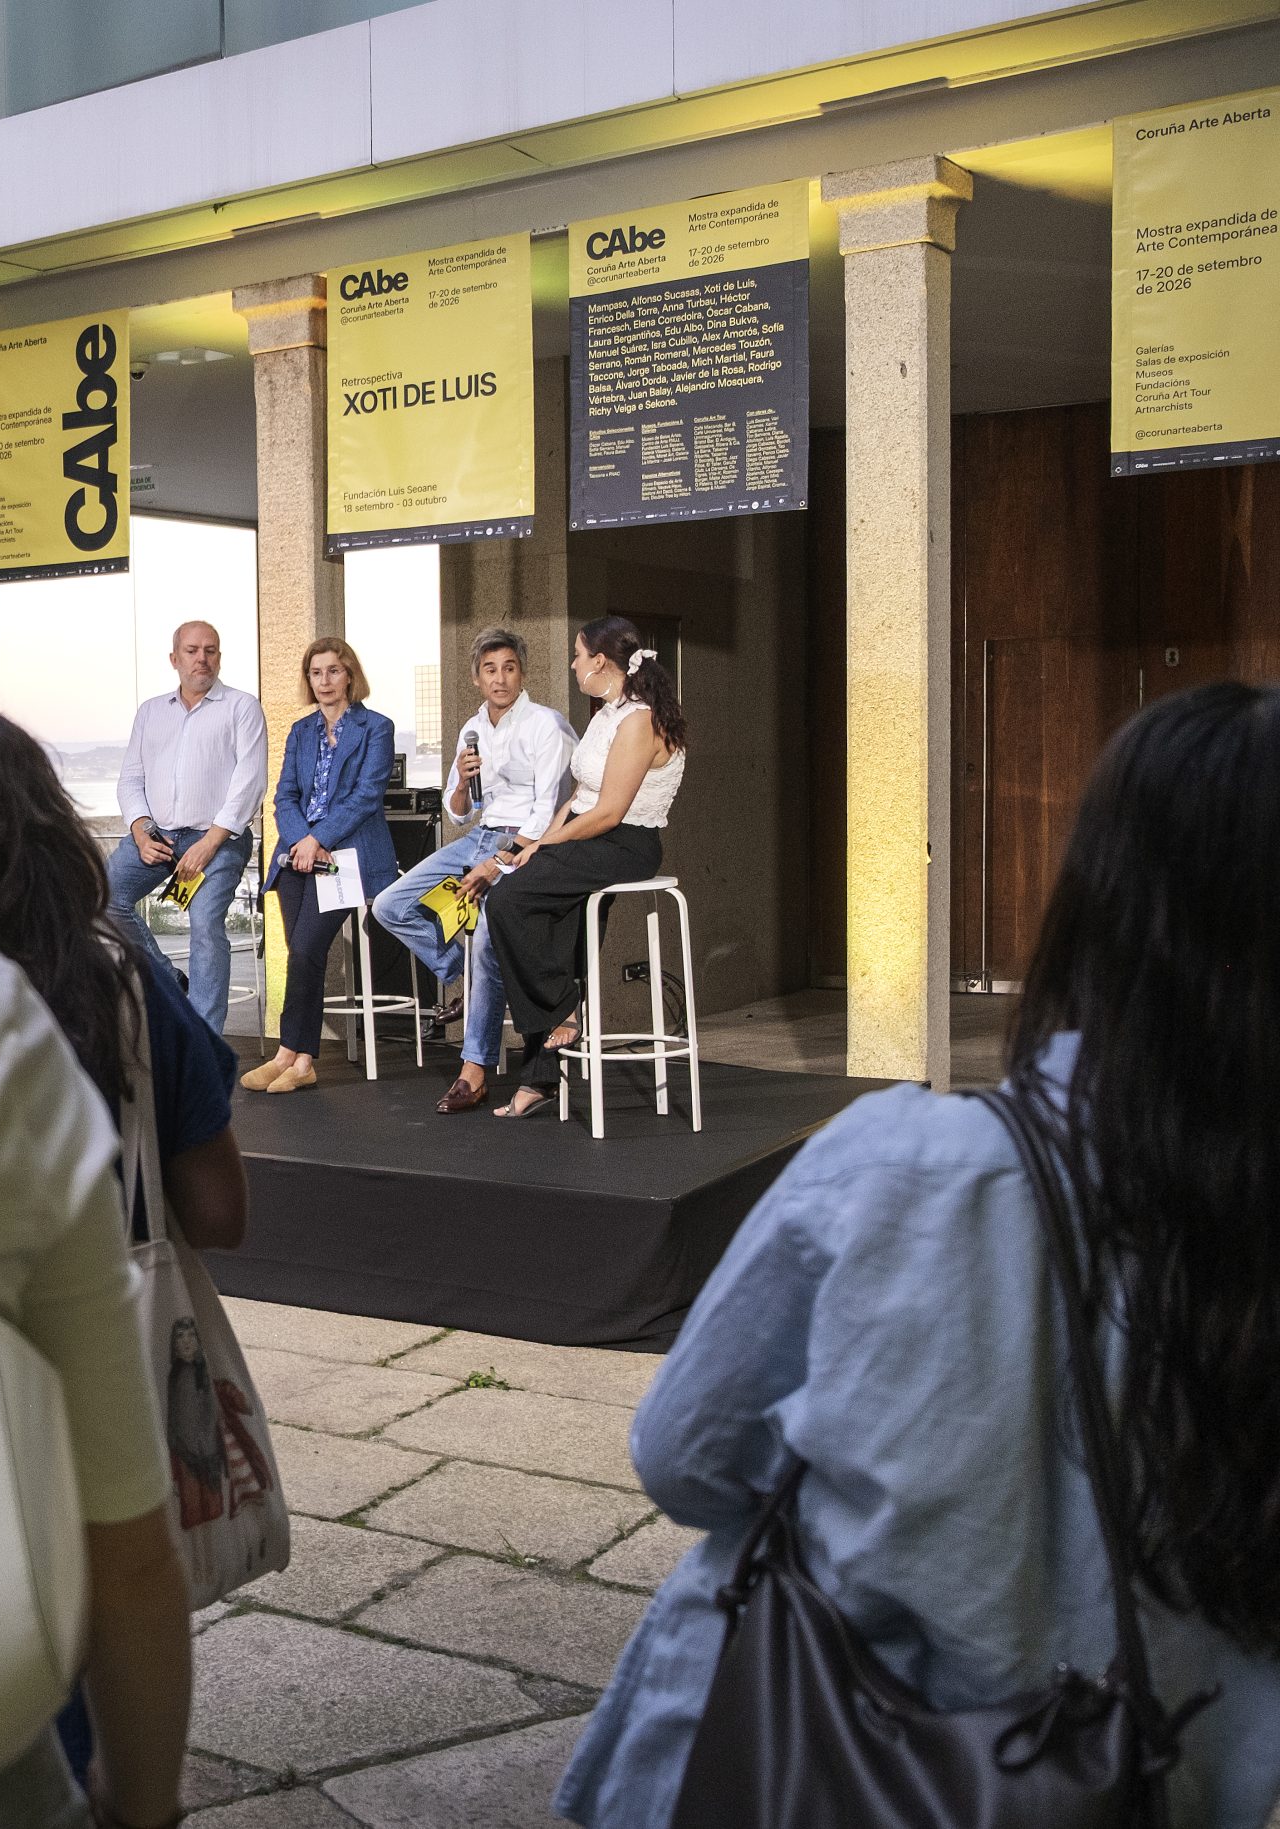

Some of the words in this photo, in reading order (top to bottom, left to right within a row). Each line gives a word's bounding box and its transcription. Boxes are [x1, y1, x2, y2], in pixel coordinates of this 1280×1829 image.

[1136, 123, 1185, 141] Coruña
[1189, 118, 1219, 131] Arte
[1222, 108, 1271, 125] Aberta
[688, 211, 718, 223] Mostra
[720, 202, 766, 217] expandida
[767, 199, 779, 209] de
[688, 223, 707, 233] Arte
[708, 211, 779, 229] Contemporánea
[1137, 225, 1182, 239] Mostra
[1186, 211, 1257, 232] expandida
[1260, 208, 1278, 220] de
[586, 225, 666, 260] CAbe
[689, 245, 713, 257] 17-20
[714, 244, 726, 253] de
[727, 238, 770, 251] setembro
[1136, 241, 1164, 253] Arte
[1168, 224, 1278, 249] Contemporánea
[428, 257, 454, 267] Mostra
[455, 248, 495, 262] expandida
[496, 246, 507, 255] de
[586, 263, 616, 275] Coruña
[618, 260, 636, 270] Arte
[637, 255, 666, 266] Aberta
[688, 259, 700, 268] de
[701, 253, 724, 265] 2026
[428, 268, 444, 276] Arte
[445, 257, 507, 273] Contemporánea
[1136, 266, 1174, 281] 17-20
[1177, 264, 1194, 276] de
[1197, 255, 1262, 273] setembro
[340, 268, 409, 301] CAbe
[587, 266, 660, 287] @corunarteaberta
[1136, 284, 1153, 295] de
[1157, 277, 1192, 293] 2026
[428, 288, 450, 299] 17-20
[451, 287, 461, 296] de
[462, 282, 498, 294] setembro
[588, 300, 629, 314] Mampaso,
[631, 294, 662, 306] Alfonso
[664, 288, 702, 301] Sucasas,
[704, 283, 721, 294] Xoti
[723, 281, 735, 291] de
[340, 304, 366, 315] Coruña
[367, 302, 383, 310] Arte
[384, 297, 409, 307] Aberta
[428, 301, 438, 309] de
[440, 296, 460, 307] 2026
[588, 314, 614, 325] Enrico
[636, 307, 660, 317] Torre,
[662, 303, 684, 313] Anna
[686, 298, 718, 309] Turbau,
[720, 292, 751, 304] Héctor
[340, 307, 404, 325] @corunarteaberta
[588, 322, 632, 337] Francesch,
[633, 319, 656, 329] Elena
[706, 306, 733, 318] Óscar
[735, 302, 771, 314] Cabana,
[588, 338, 612, 348] Laura
[614, 330, 663, 344] Bergantiños,
[665, 326, 681, 336] Edu
[683, 323, 705, 333] Albo,
[707, 320, 727, 330] Dina
[729, 316, 759, 327] Bukva,
[588, 347, 619, 359] Manuel
[621, 344, 649, 355] Suárez,
[651, 341, 666, 350] Isra
[668, 335, 699, 347] Cubillo,
[701, 332, 721, 342] Alex
[722, 327, 760, 339] Amorós,
[761, 322, 784, 334] Sofía
[8, 341, 23, 350] Arte
[24, 337, 47, 347] Aberta
[1135, 344, 1174, 356] Galerías
[588, 360, 623, 371] Serrano,
[624, 354, 652, 366] Román
[654, 347, 691, 361] Romeral,
[693, 342, 737, 355] Mercedes
[738, 337, 772, 349] Touzón,
[1136, 358, 1162, 367] Salas
[1163, 356, 1176, 364] de
[1178, 349, 1230, 363] exposición
[588, 371, 625, 382] Taccone,
[627, 367, 650, 377] Jorge
[651, 360, 689, 373] Taboada,
[691, 356, 713, 367] Mich
[715, 351, 748, 364] Martial,
[750, 349, 775, 360] Faura
[1136, 369, 1173, 379] Museos
[341, 371, 403, 387] Retrospectiva
[589, 383, 613, 394] Balsa,
[615, 379, 641, 390] Álvaro
[642, 375, 669, 386] Dorda,
[670, 371, 696, 382] Javier
[698, 369, 710, 379] de
[711, 367, 719, 377] la
[721, 366, 746, 375] Rosa,
[748, 360, 782, 372] Rodrigo
[1135, 379, 1191, 391] Fundacións
[343, 386, 397, 416] XOTI
[404, 380, 435, 408] DE
[442, 372, 497, 402] LUIS
[588, 394, 626, 405] Vértebra,
[628, 391, 648, 400] Juan
[649, 386, 673, 397] Balay,
[675, 380, 716, 394] Alejandro
[718, 375, 764, 388] Mosquera,
[1135, 392, 1170, 403] Coruña
[1172, 390, 1187, 399] Art
[1190, 388, 1211, 397] Tour
[8, 407, 42, 420] expandida
[43, 406, 52, 414] de
[589, 406, 612, 417] Richy
[613, 403, 637, 414] Veiga
[645, 398, 678, 410] Sekone.
[1135, 402, 1193, 415] Artnarchists
[0, 417, 52, 431] Contemporánea
[1135, 423, 1223, 440] @corunarteaberta
[4, 441, 13, 450] de
[14, 437, 45, 448] setembro
[62, 323, 118, 552] CAbe
[343, 489, 386, 501] Fundación
[388, 486, 405, 496] Luis
[407, 484, 437, 494] Seoane
[7, 502, 32, 510] exposición
[343, 504, 353, 513] 18
[355, 502, 394, 512] setembro
[402, 498, 413, 508] 03
[415, 496, 447, 506] outubro
